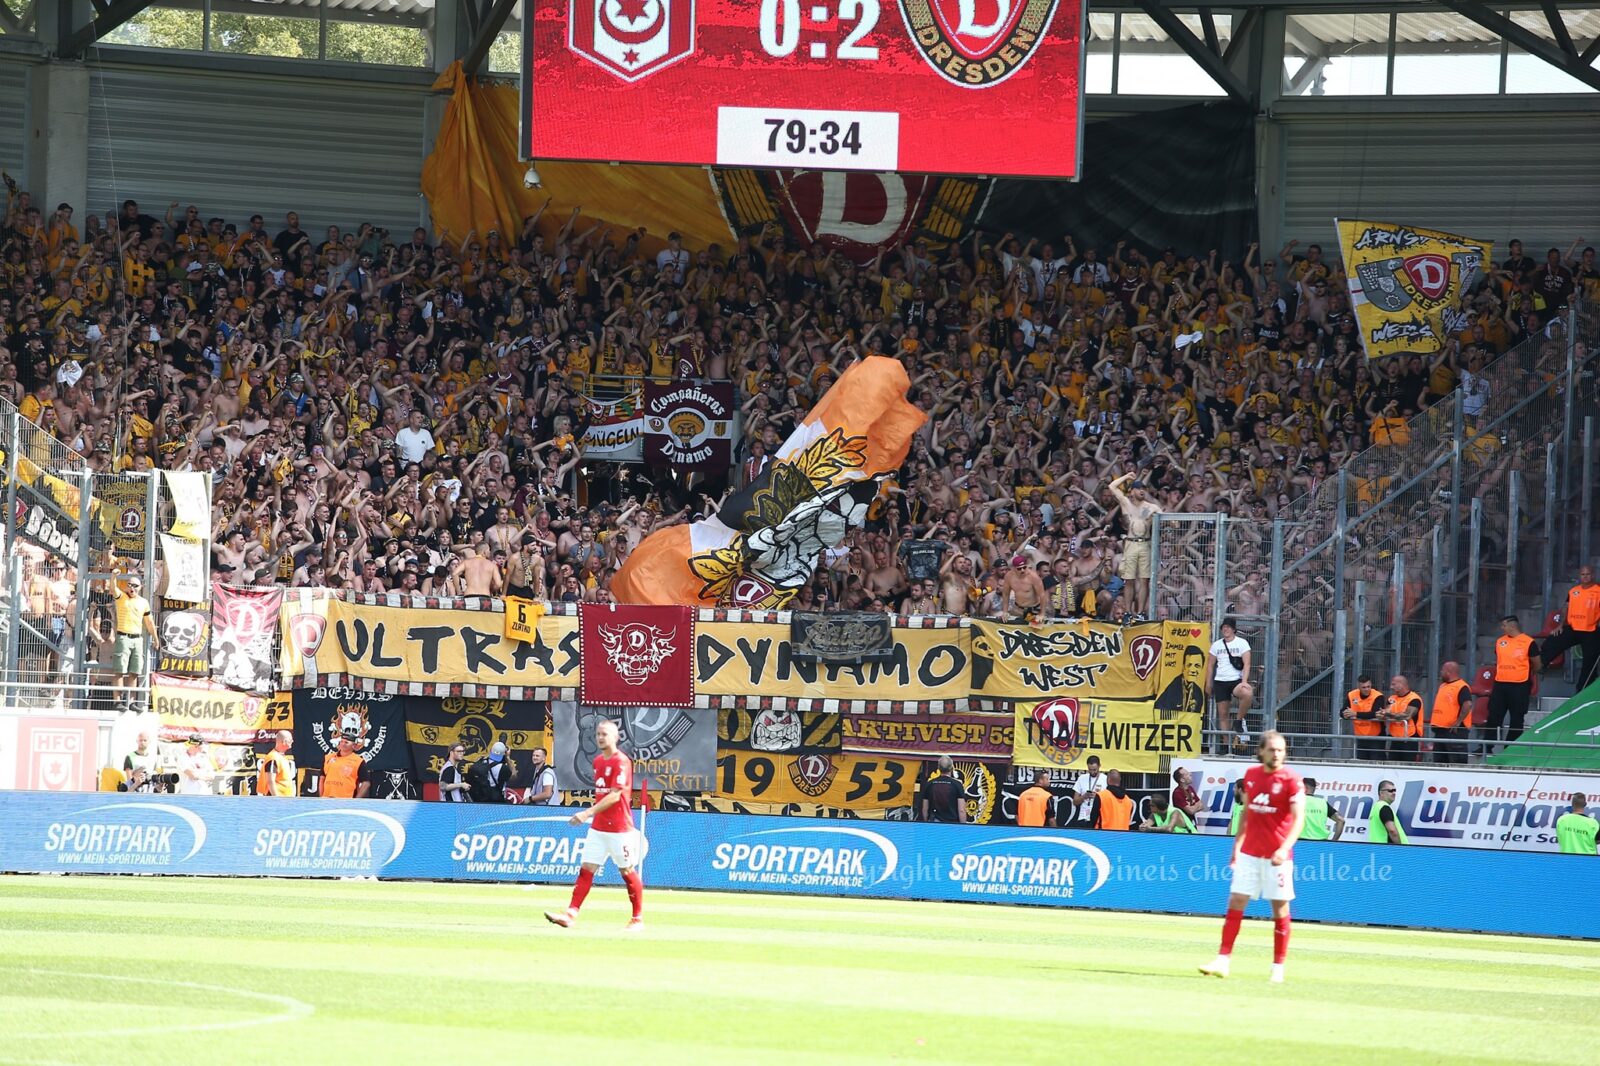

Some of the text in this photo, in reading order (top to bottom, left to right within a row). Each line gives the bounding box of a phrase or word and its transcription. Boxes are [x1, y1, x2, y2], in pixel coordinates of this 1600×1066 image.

[759, 0, 880, 60] 0:2
[918, 26, 1037, 84] DRESDEN
[764, 118, 862, 155] 79:34
[651, 387, 726, 416] Compañeros
[518, 604, 527, 623] 6
[998, 630, 1122, 660] DRESDEN
[1018, 663, 1107, 692] WEST
[157, 696, 236, 720] BRIGADE
[265, 702, 291, 721] 53
[1091, 703, 1107, 719] IE
[37, 735, 77, 750] HFC
[716, 754, 776, 797] 19
[793, 775, 832, 797] DRESDEN
[846, 761, 903, 802] 53
[1467, 786, 1600, 803] Wohn-Centrm
[44, 822, 176, 852] SPORTPARK
[253, 828, 377, 858] SPORTPARK
[1471, 832, 1494, 841] an
[1500, 831, 1532, 843] der
[57, 852, 171, 865] WWW.MEIN-SPORTPARK.DE
[623, 845, 630, 857] 5
[711, 842, 868, 876] SPORTPARK
[264, 857, 372, 870] WWW.MEIN-SPORTPARK.DE
[949, 853, 1078, 888] SPORTPARK
[728, 870, 863, 888] WWW.MEIN-SPORTPARK.DE
[961, 882, 1074, 898] WWW.MEIN-SPORTPARK.DE
[1278, 873, 1285, 888] 3
